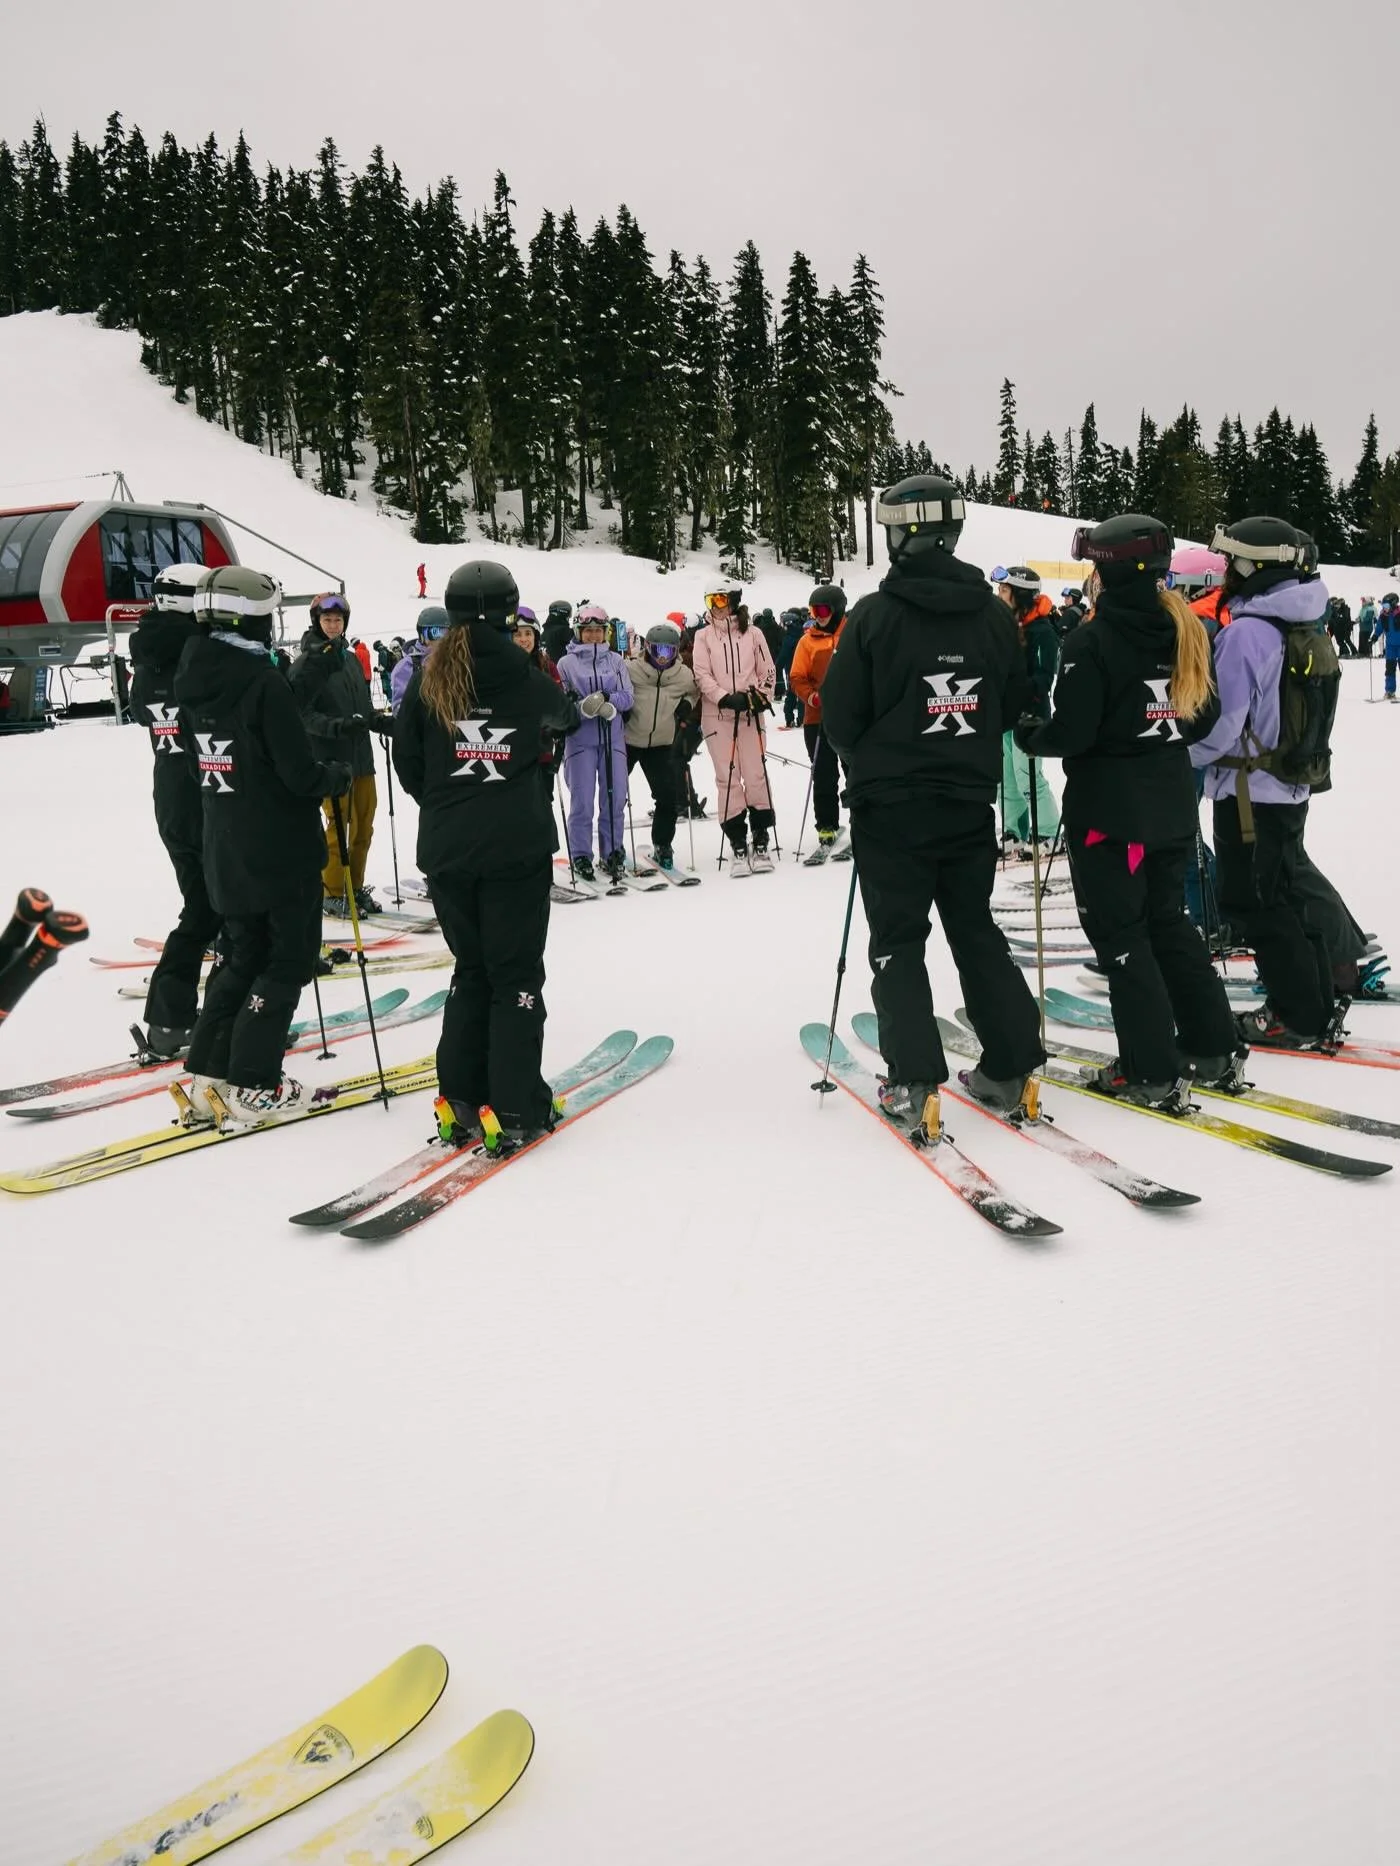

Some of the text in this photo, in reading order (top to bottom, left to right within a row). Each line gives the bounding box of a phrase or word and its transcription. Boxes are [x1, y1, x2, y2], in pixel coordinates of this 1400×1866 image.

[929, 695, 976, 705] EXTREMELY
[928, 704, 977, 714] CANADIAN
[458, 743, 509, 752] EXTREMELY
[457, 751, 509, 760] CANADIAN
[200, 763, 232, 771] CANADIAN
